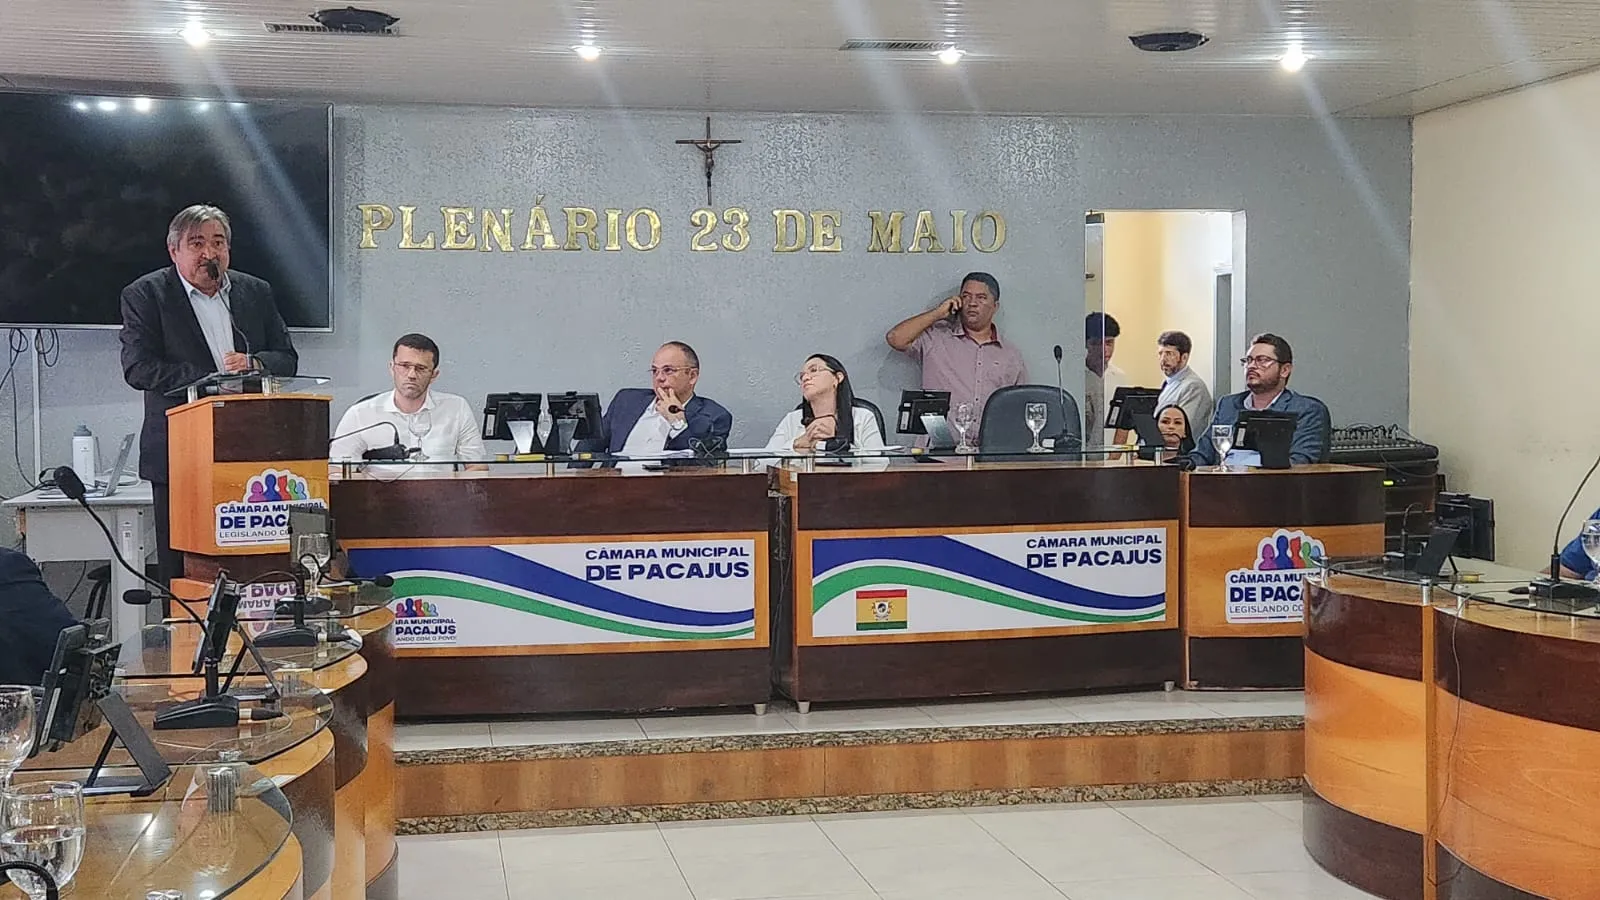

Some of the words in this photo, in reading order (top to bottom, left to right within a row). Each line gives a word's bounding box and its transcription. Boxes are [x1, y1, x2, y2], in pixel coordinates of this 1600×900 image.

[358, 194, 662, 252] PLENÁRIO
[690, 208, 750, 252] 23
[773, 208, 843, 252] DE
[867, 209, 1008, 253] MAIO
[220, 504, 270, 514] CÂMARA
[220, 516, 246, 529] DE
[250, 514, 288, 528] PAC
[219, 530, 277, 538] LEGISLANDO
[1026, 536, 1087, 549] CÂMARA
[1091, 535, 1162, 546] MUNICIPAL
[585, 547, 657, 560] CÂMARA
[662, 547, 750, 558] MUNICIPAL
[1026, 553, 1057, 569] DE
[1062, 549, 1162, 567] PACAJUS
[586, 565, 621, 581] DE
[628, 562, 750, 580] PACAJUS
[1230, 573, 1281, 583] CÂMARA
[1229, 587, 1257, 602] DE
[1261, 585, 1304, 602] PAC
[1229, 604, 1290, 614] LEGISLANDO
[395, 625, 456, 635] PACAJUS
